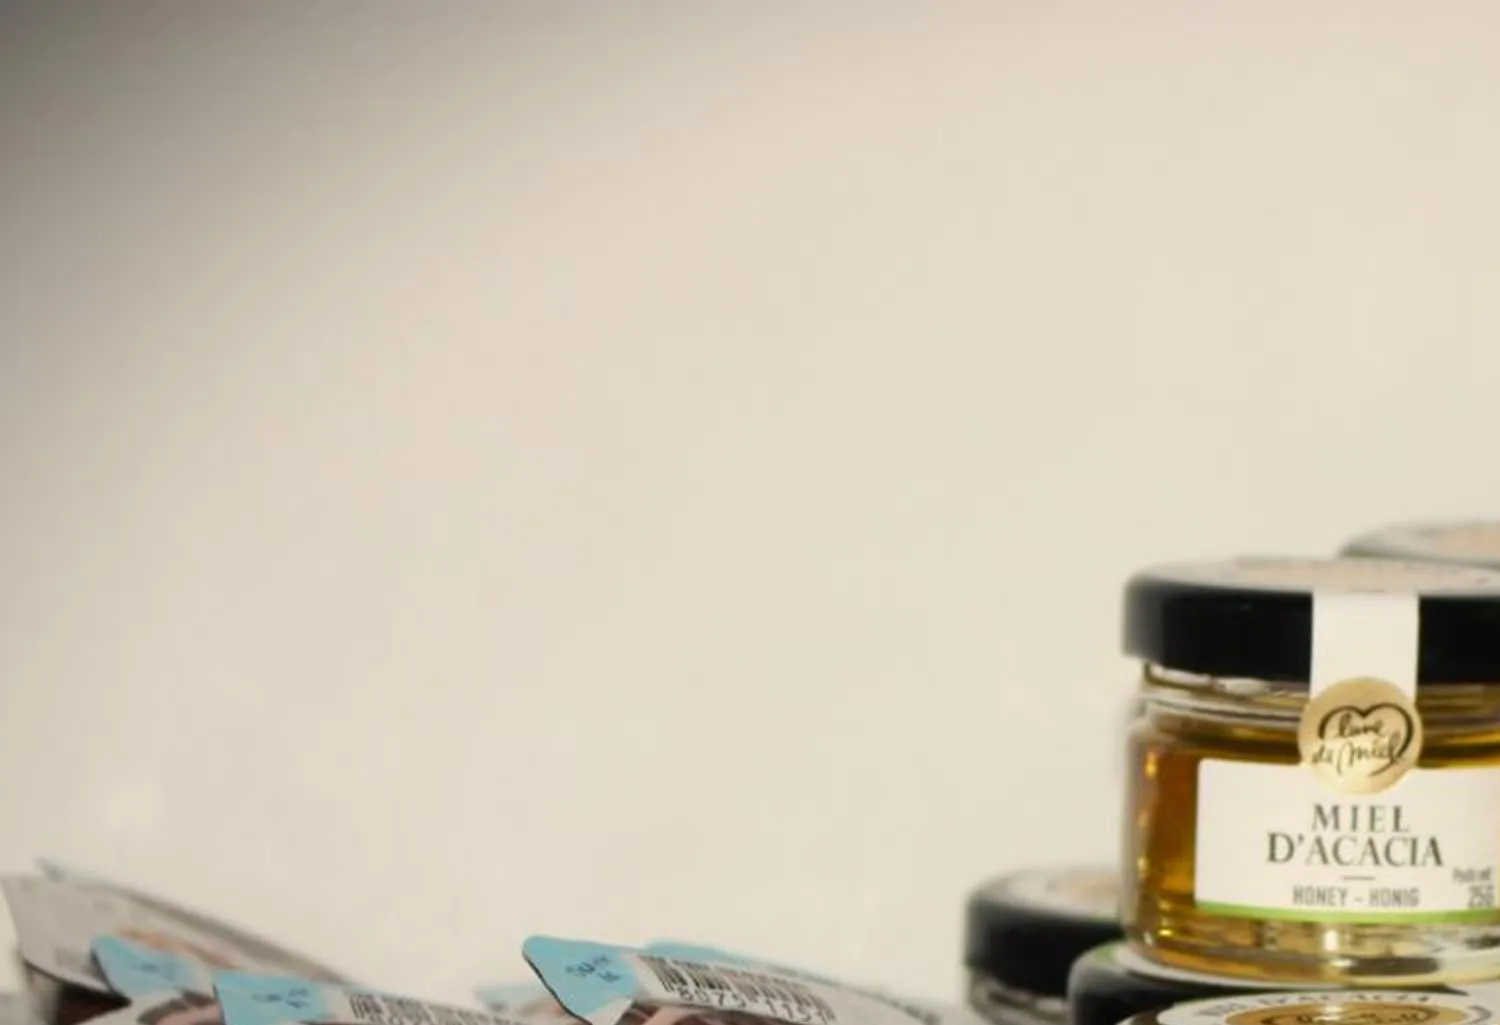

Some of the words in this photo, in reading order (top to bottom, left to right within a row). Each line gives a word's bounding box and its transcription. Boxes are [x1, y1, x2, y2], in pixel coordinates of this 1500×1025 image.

[1311, 803, 1409, 833] MIEL
[1266, 831, 1444, 868] D'ACACIA
[1292, 885, 1349, 907] HONEY
[1368, 887, 1421, 908] HONIG
